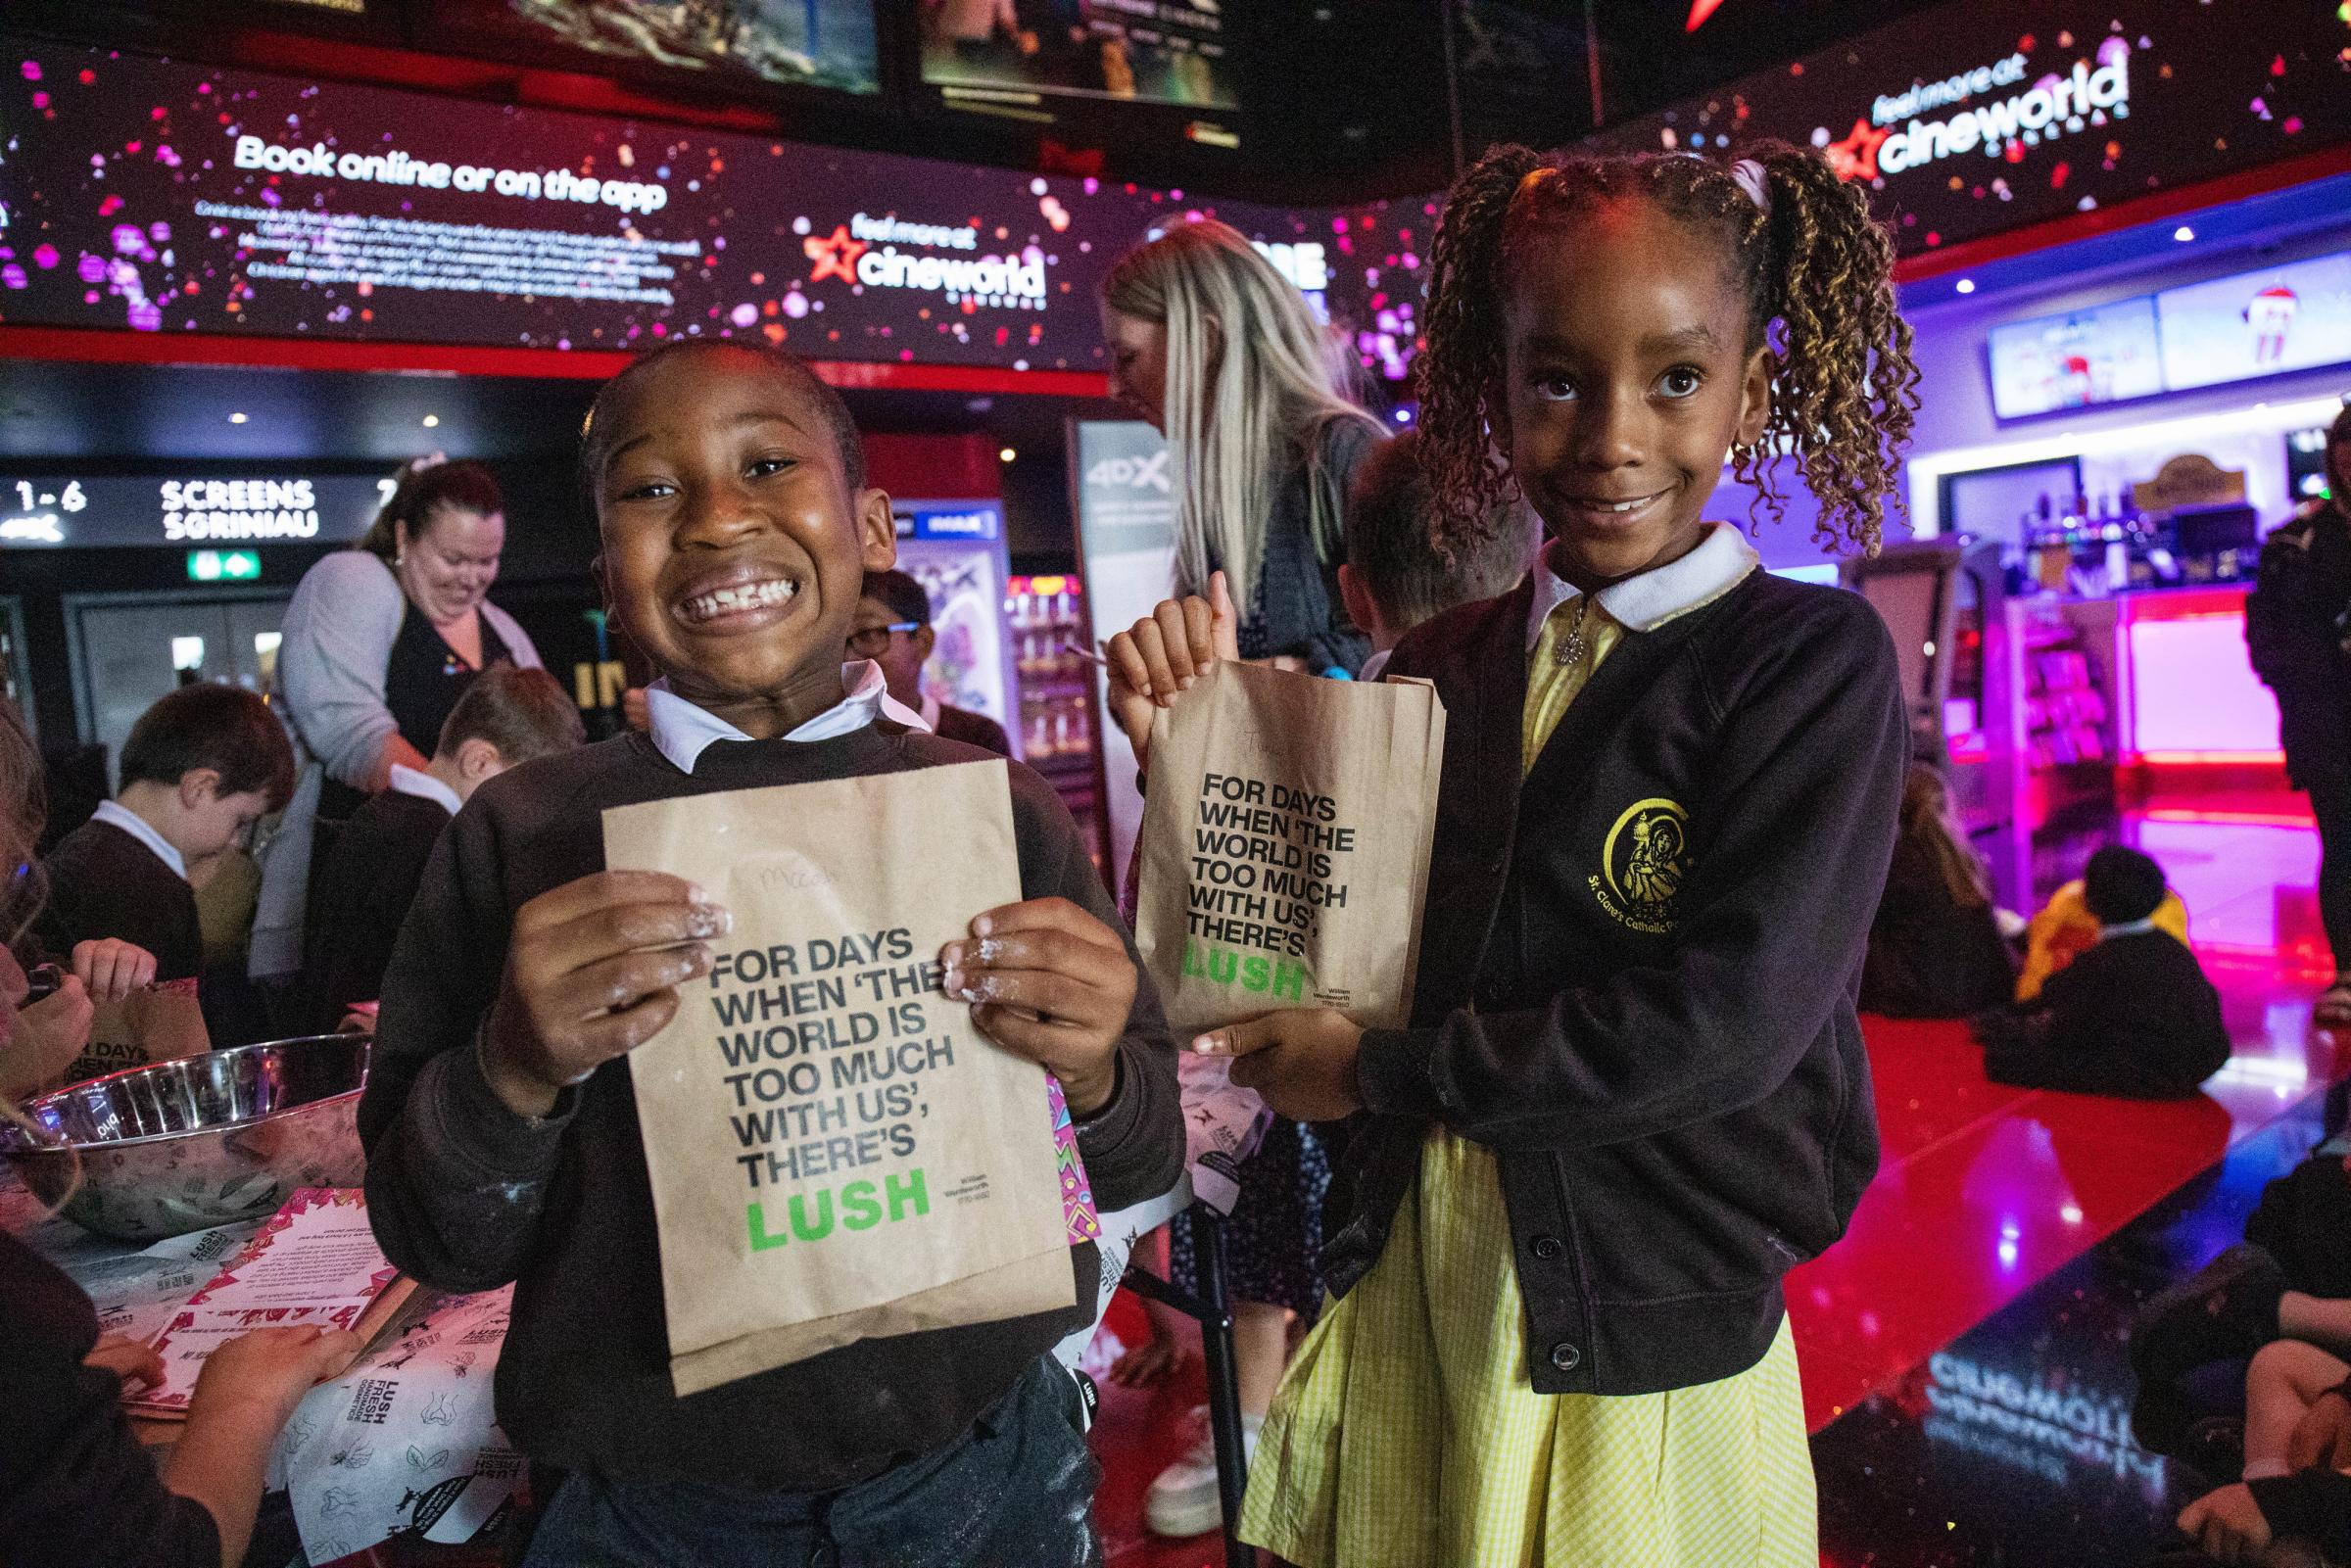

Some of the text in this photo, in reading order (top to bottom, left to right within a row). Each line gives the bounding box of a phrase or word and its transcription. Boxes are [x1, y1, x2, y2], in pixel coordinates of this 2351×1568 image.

[1878, 49, 2130, 174] cineworld
[234, 134, 668, 215] Book online or on the app
[857, 245, 1046, 298] cineworld
[161, 479, 316, 511] SCREENS
[163, 509, 319, 541] SGRINIAU
[1200, 800, 1289, 839] WHEN
[1202, 772, 1336, 822] FOR DAYS
[1196, 829, 1331, 879] WORLD IS
[1188, 883, 1267, 920] WITH
[1191, 856, 1347, 909] TOO MUCH
[1625, 917, 1666, 933] Catholic
[709, 927, 913, 989] FOR DAYS
[1182, 940, 1307, 1003] LUSH
[710, 976, 846, 1027] WHEN
[716, 1002, 927, 1068] WORLD IS
[724, 1035, 954, 1107] TOO MUCH
[730, 1096, 847, 1147] WITH
[745, 1167, 930, 1253] LUSH
[347, 1378, 367, 1421] COSMETICS
[355, 1379, 375, 1423] HANDMADE
[361, 1379, 387, 1424] FRESH
[373, 1380, 399, 1424] LUSH
[1083, 1382, 1096, 1407] LUSH
